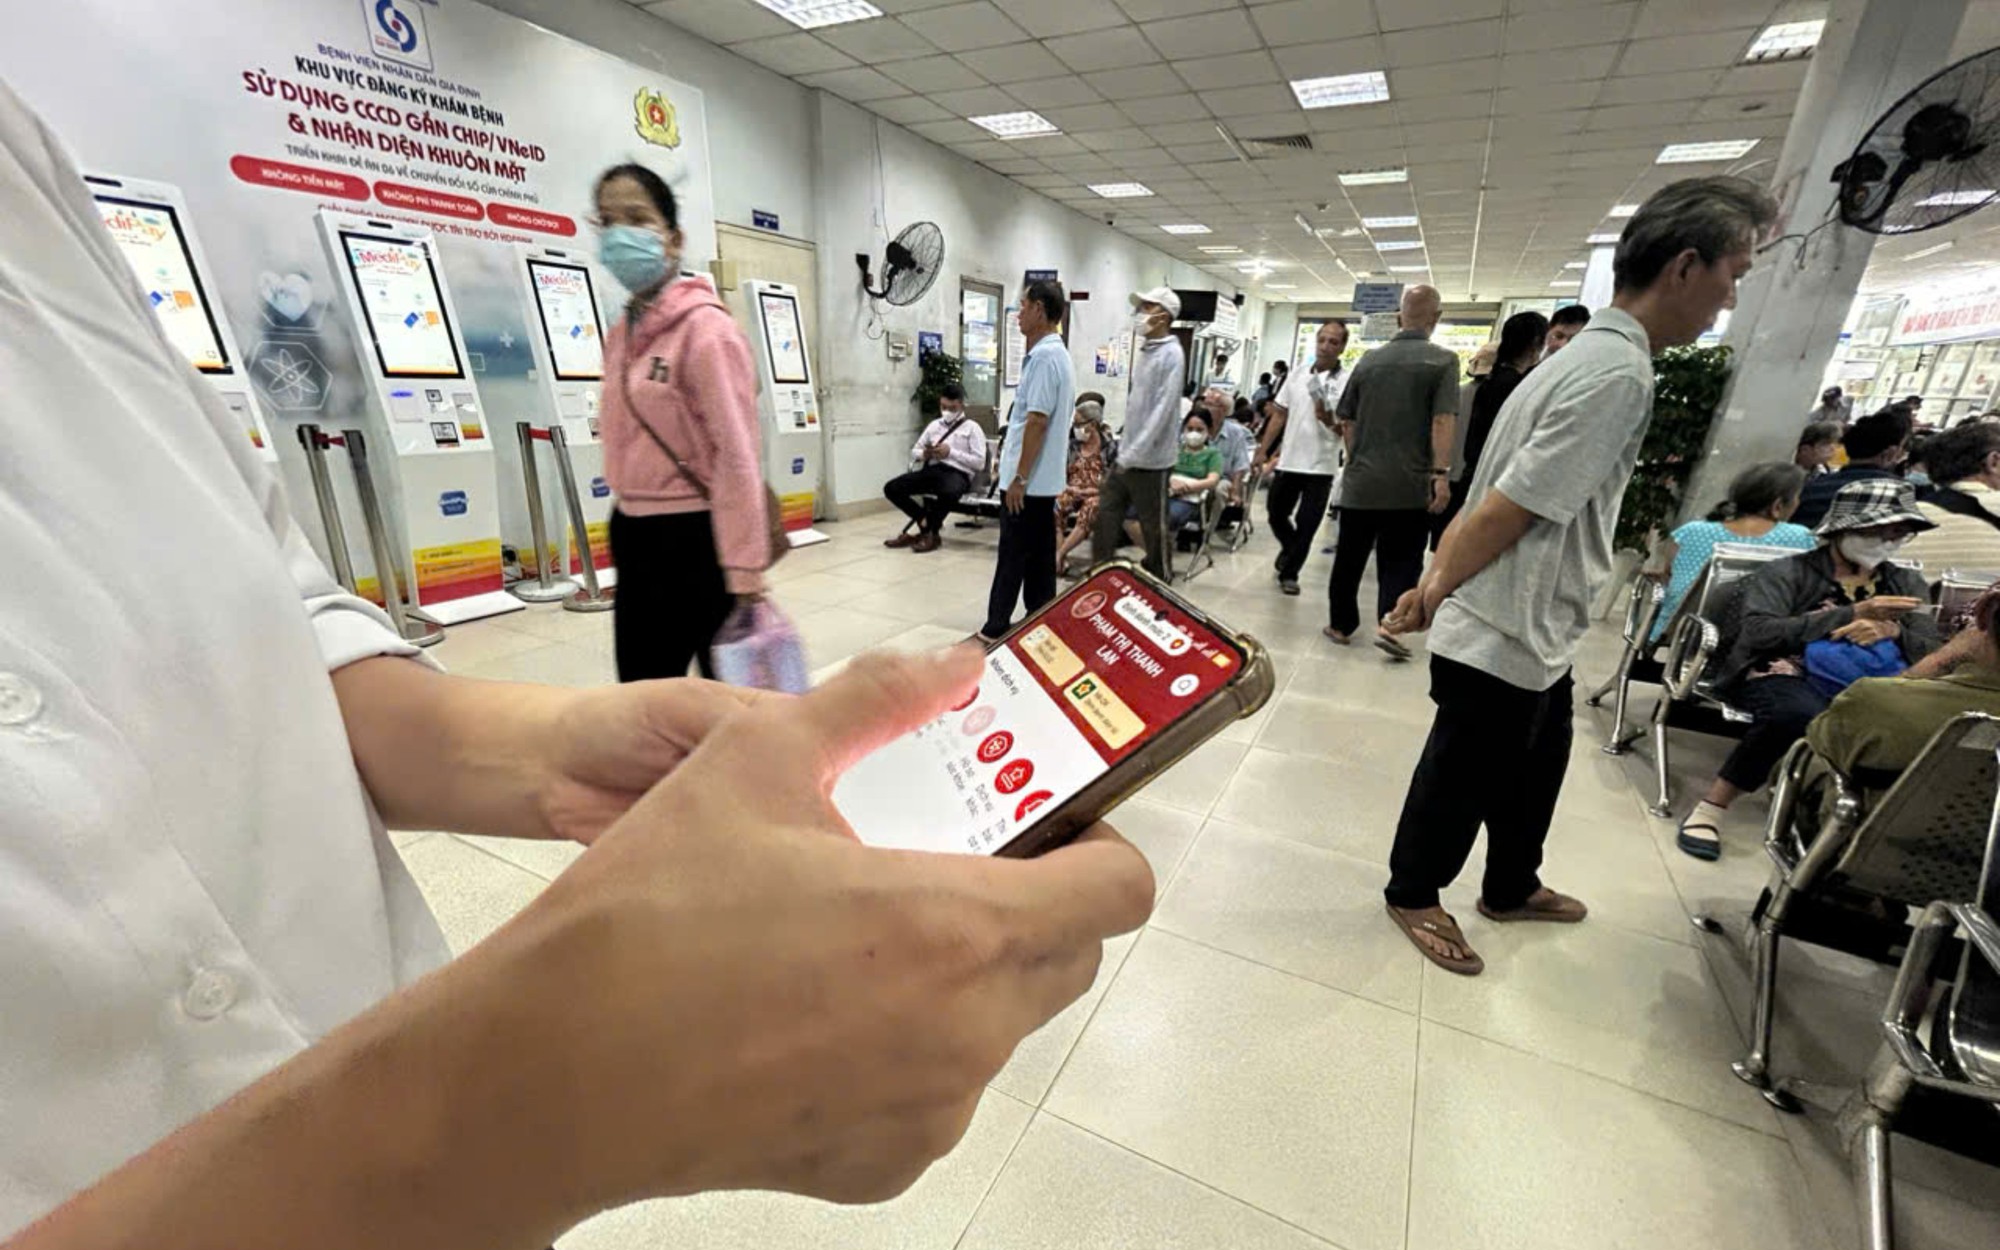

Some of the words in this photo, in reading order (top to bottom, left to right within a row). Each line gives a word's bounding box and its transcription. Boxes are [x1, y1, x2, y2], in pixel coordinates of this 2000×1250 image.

[242, 67, 277, 97] SỬ
[279, 79, 349, 114] DỤNG
[353, 99, 402, 126] CCCD
[406, 110, 449, 139] GẮN
[295, 55, 330, 79] KHU
[331, 66, 367, 89] VỰC
[367, 76, 408, 100] ĐĂNG
[410, 84, 427, 105] KÝ
[429, 93, 470, 117] KHÁM
[470, 104, 504, 126] BỆNH
[288, 112, 308, 135] &
[311, 117, 374, 150] NHẬN
[377, 133, 425, 161] DIỆN
[427, 144, 491, 175] KHUÔN
[494, 159, 527, 185] MẶT
[1089, 613, 1118, 638] PHẠM
[1112, 632, 1133, 653] THỊ
[1126, 644, 1165, 678] THANH
[1096, 644, 1120, 666] LAN
